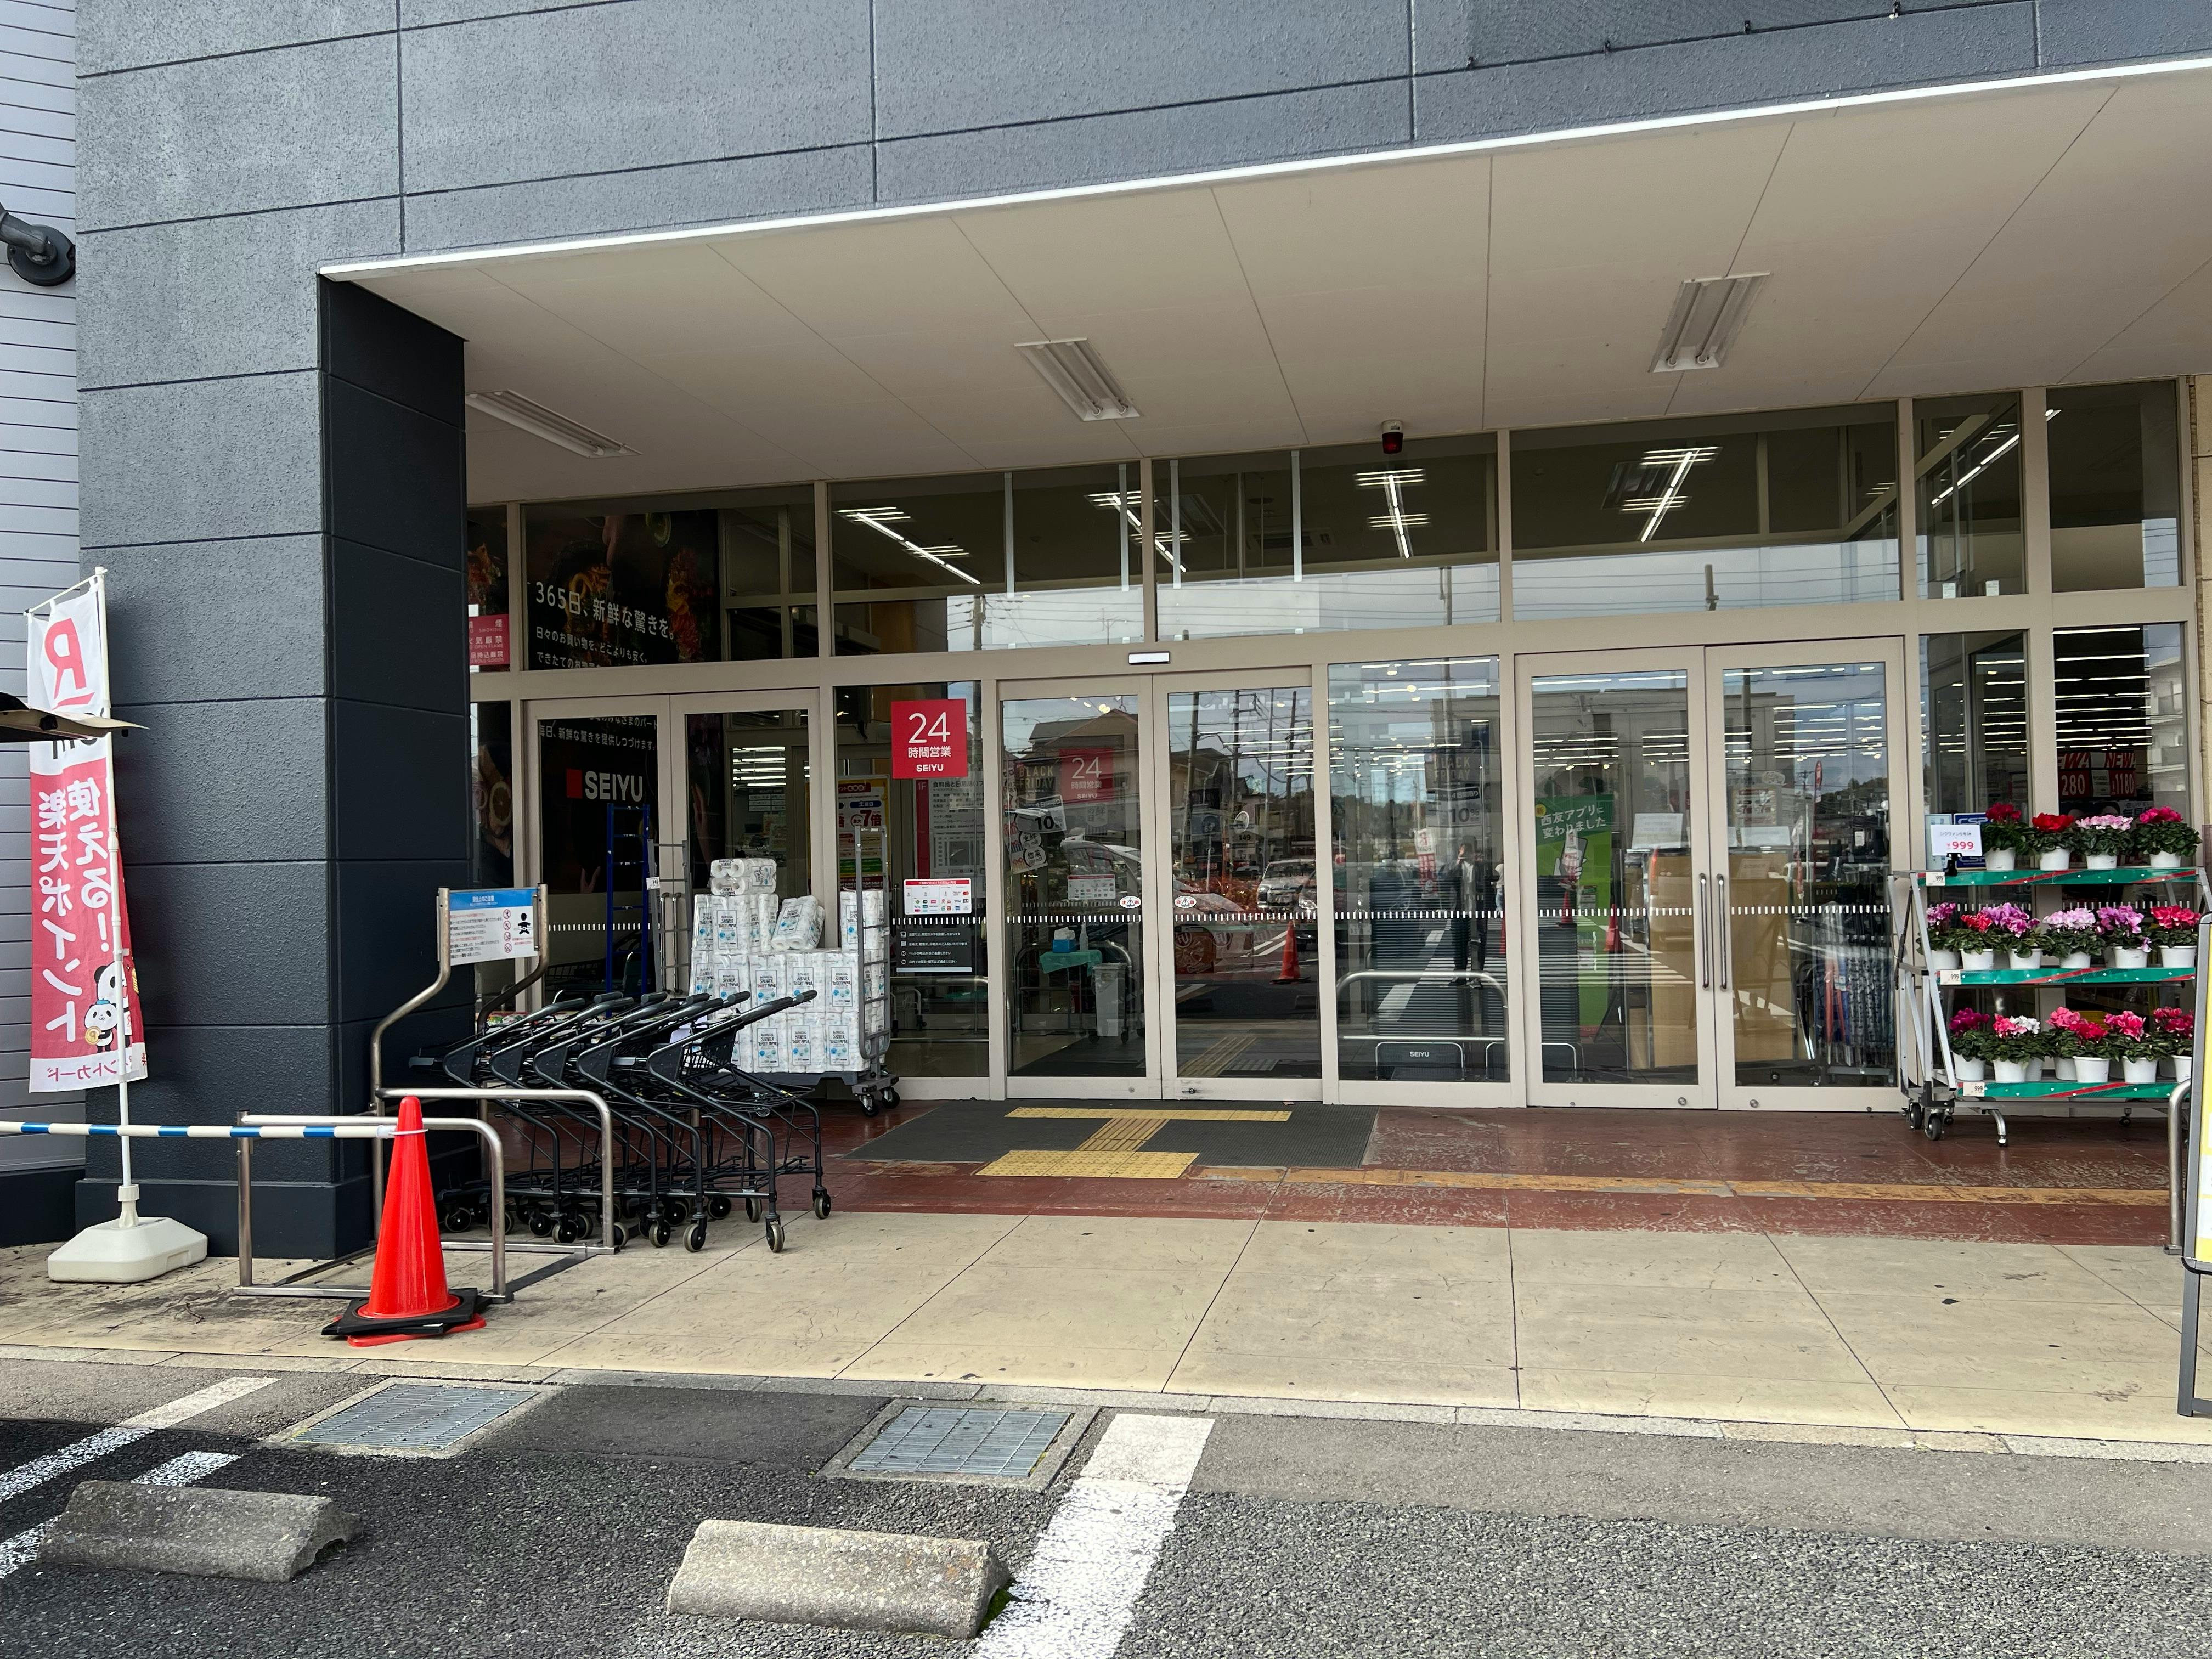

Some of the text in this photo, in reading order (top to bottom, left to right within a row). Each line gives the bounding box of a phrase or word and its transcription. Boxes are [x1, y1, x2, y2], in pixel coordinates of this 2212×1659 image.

[535, 581, 674, 640] 365日、新鮮な驚きを。
[908, 712, 951, 744] 24
[907, 746, 952, 758] 時間営業
[916, 764, 944, 772] SEIYU
[1019, 765, 1054, 777] BLACK
[1071, 756, 1102, 780] 24
[584, 770, 643, 802] SEIYU
[918, 782, 927, 791] 1F
[1019, 777, 1054, 789] FRIDAY
[1070, 781, 1102, 789] 時間営業
[2061, 774, 2085, 796] 280
[1541, 804, 1604, 826] 西友アプリに
[1542, 817, 1606, 839] 変わりました
